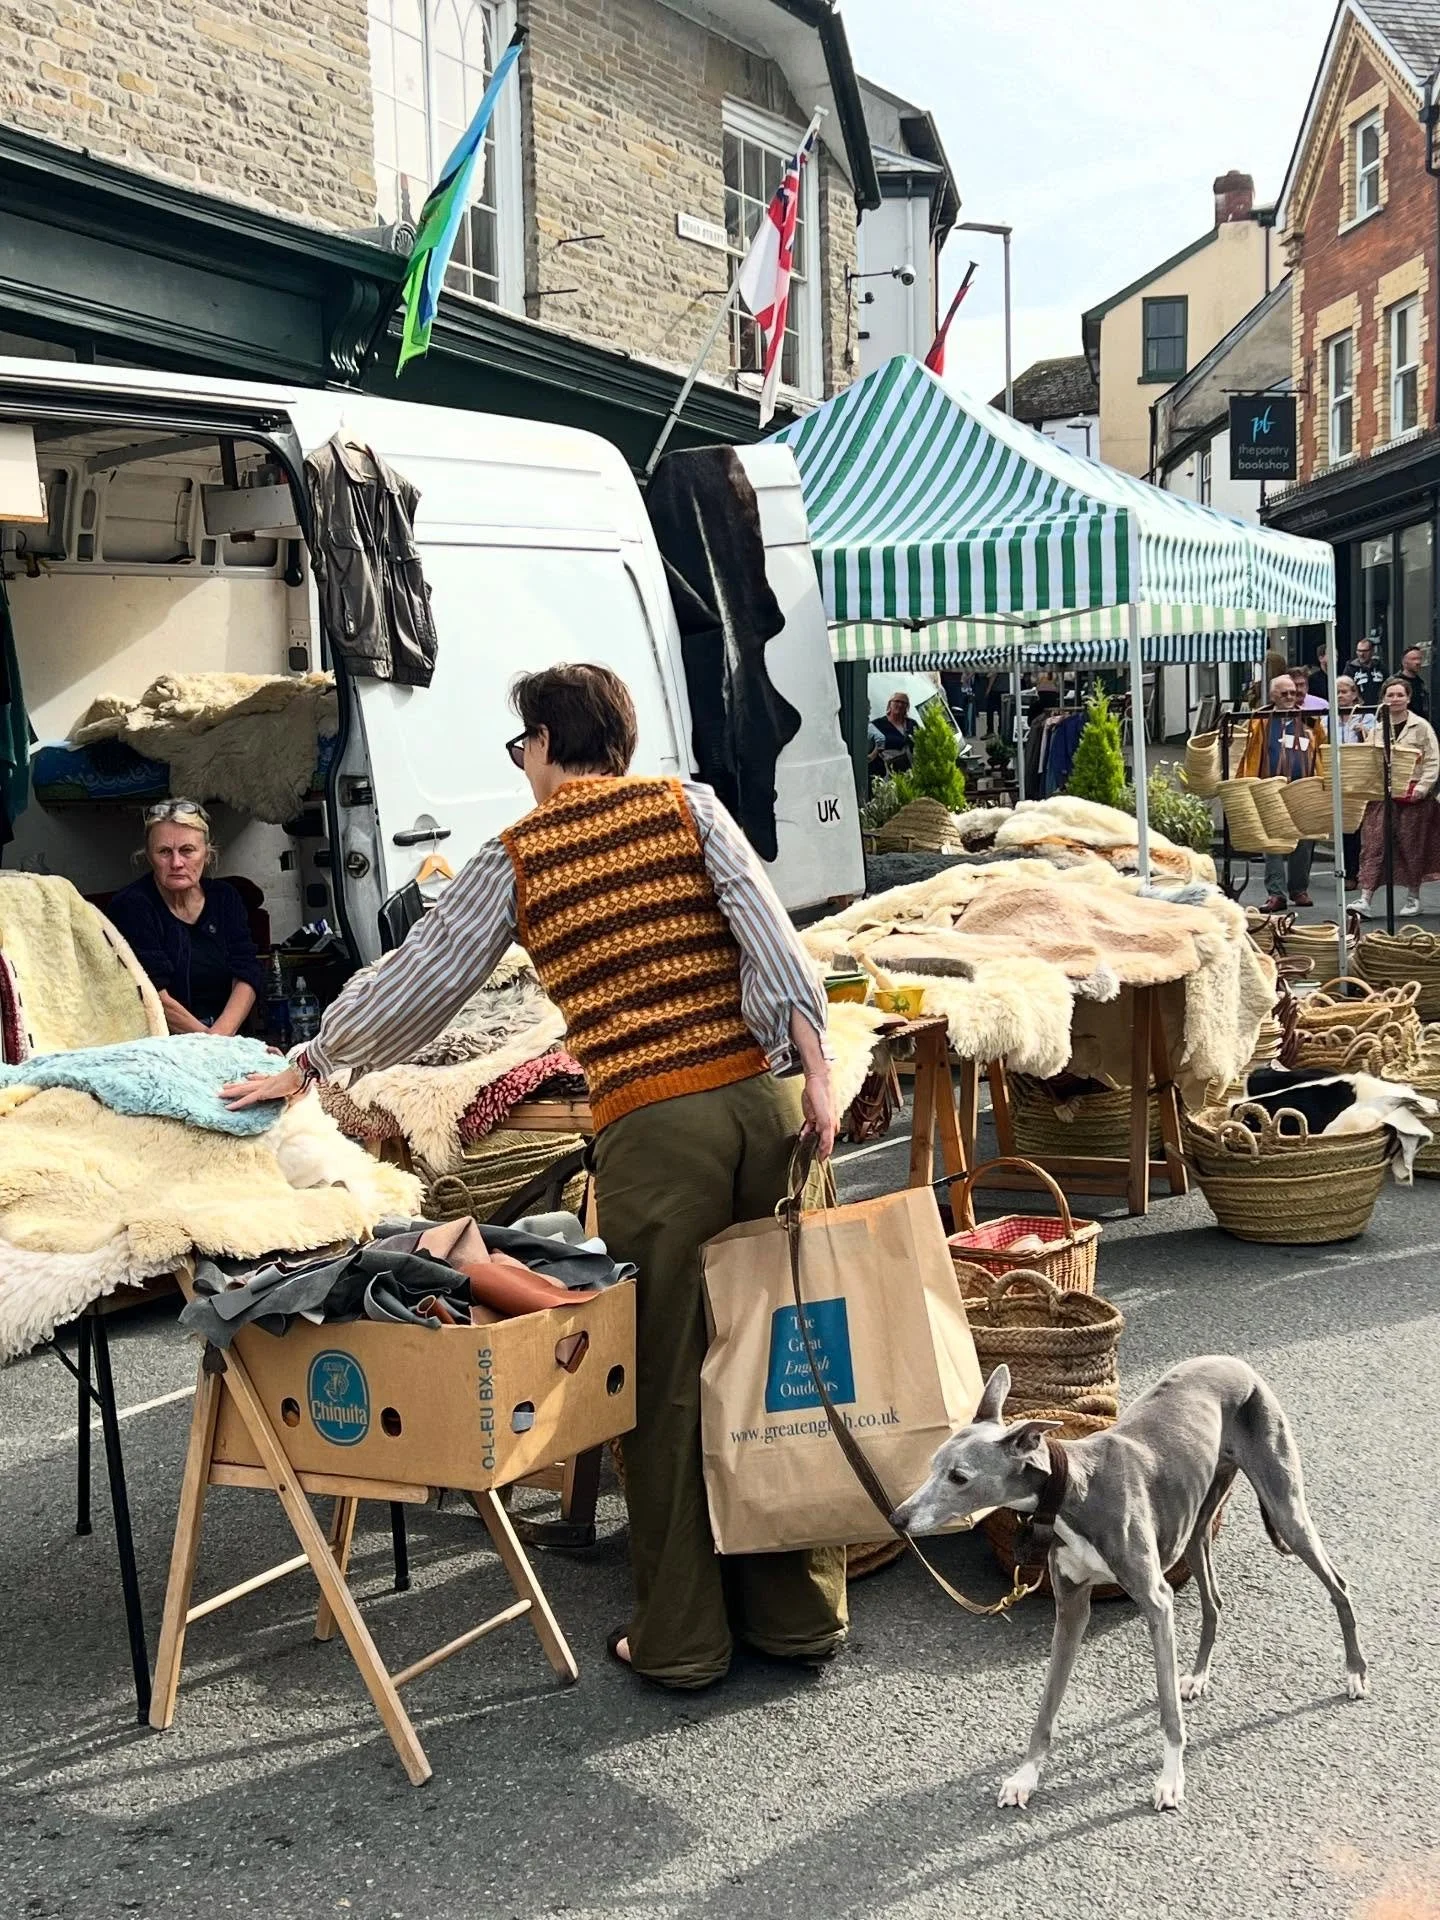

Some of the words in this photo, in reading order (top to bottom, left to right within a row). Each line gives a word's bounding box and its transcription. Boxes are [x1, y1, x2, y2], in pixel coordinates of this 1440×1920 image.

[1238, 460, 1290, 472] bookshop
[817, 798, 841, 823] UK
[788, 1337, 823, 1353] Grat
[478, 1348, 494, 1401] BX-05
[311, 1400, 368, 1429] Chiquita
